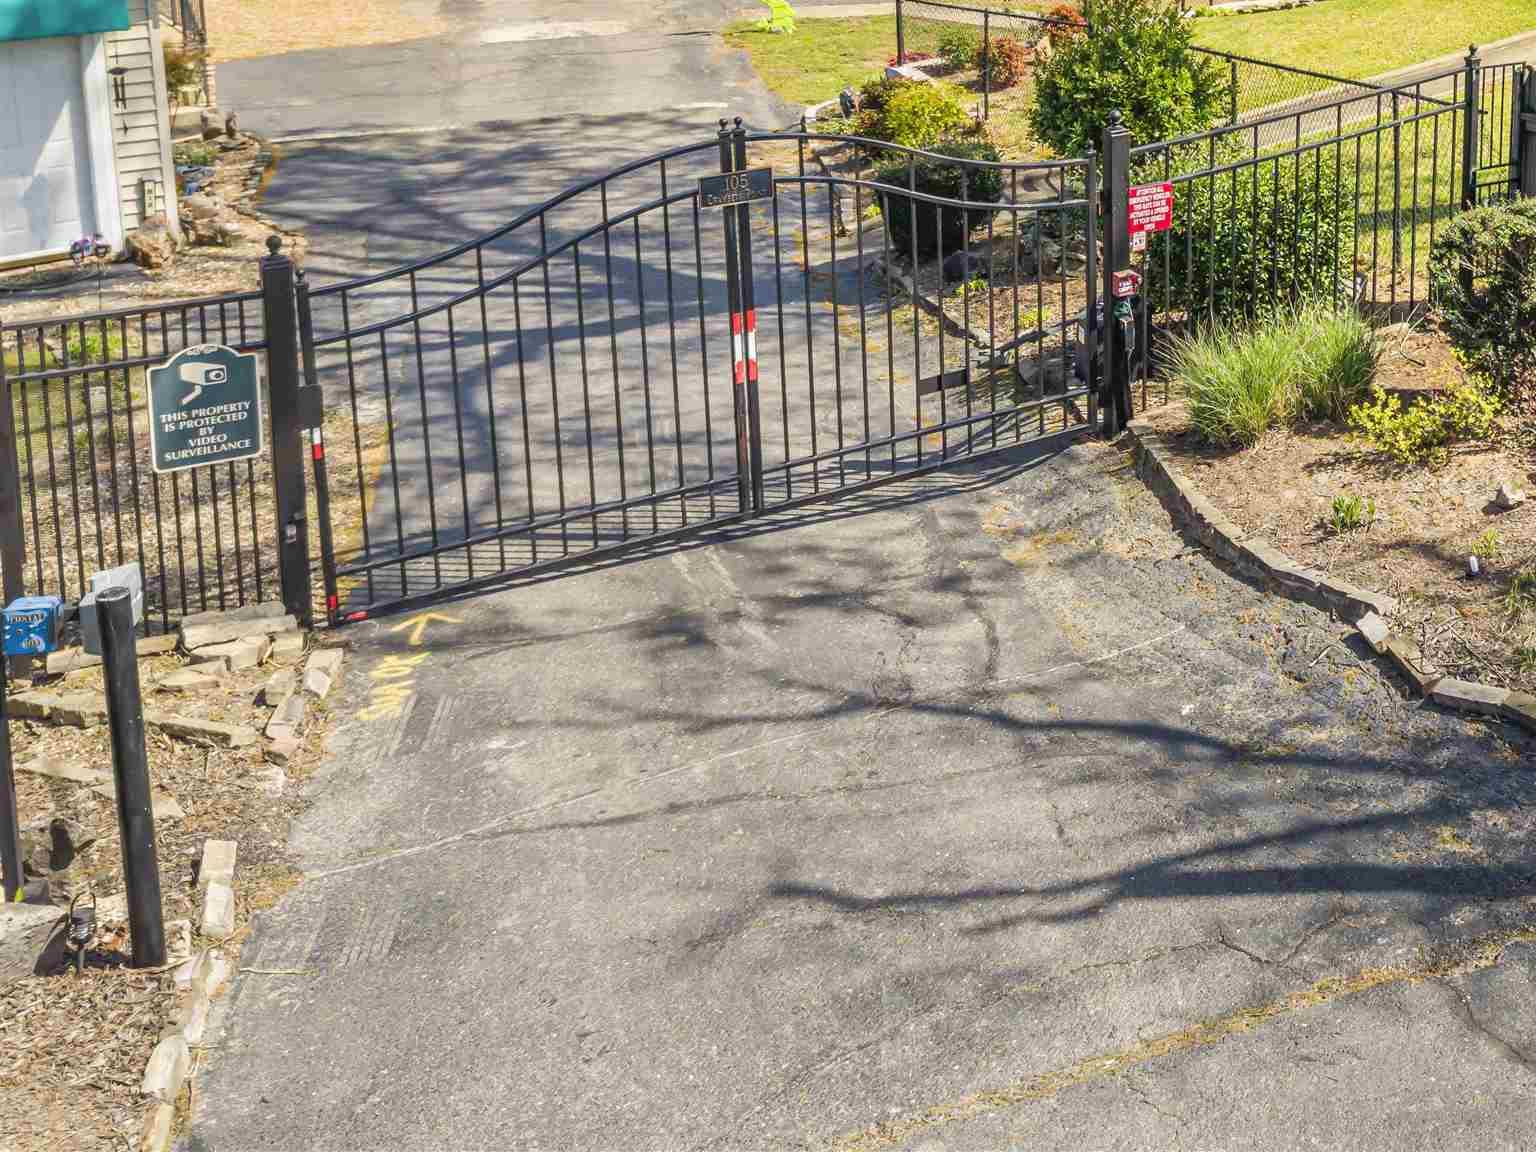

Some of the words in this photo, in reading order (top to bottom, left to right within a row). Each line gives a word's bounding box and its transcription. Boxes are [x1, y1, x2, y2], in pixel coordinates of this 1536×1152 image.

[160, 412, 188, 423] THIS
[192, 401, 251, 417] PROPERTY
[164, 423, 175, 433] IS
[179, 411, 248, 430] PROTECTED
[188, 433, 228, 447] VIDEO
[199, 426, 215, 436] BY
[164, 439, 252, 461] SURVEILLANCE
